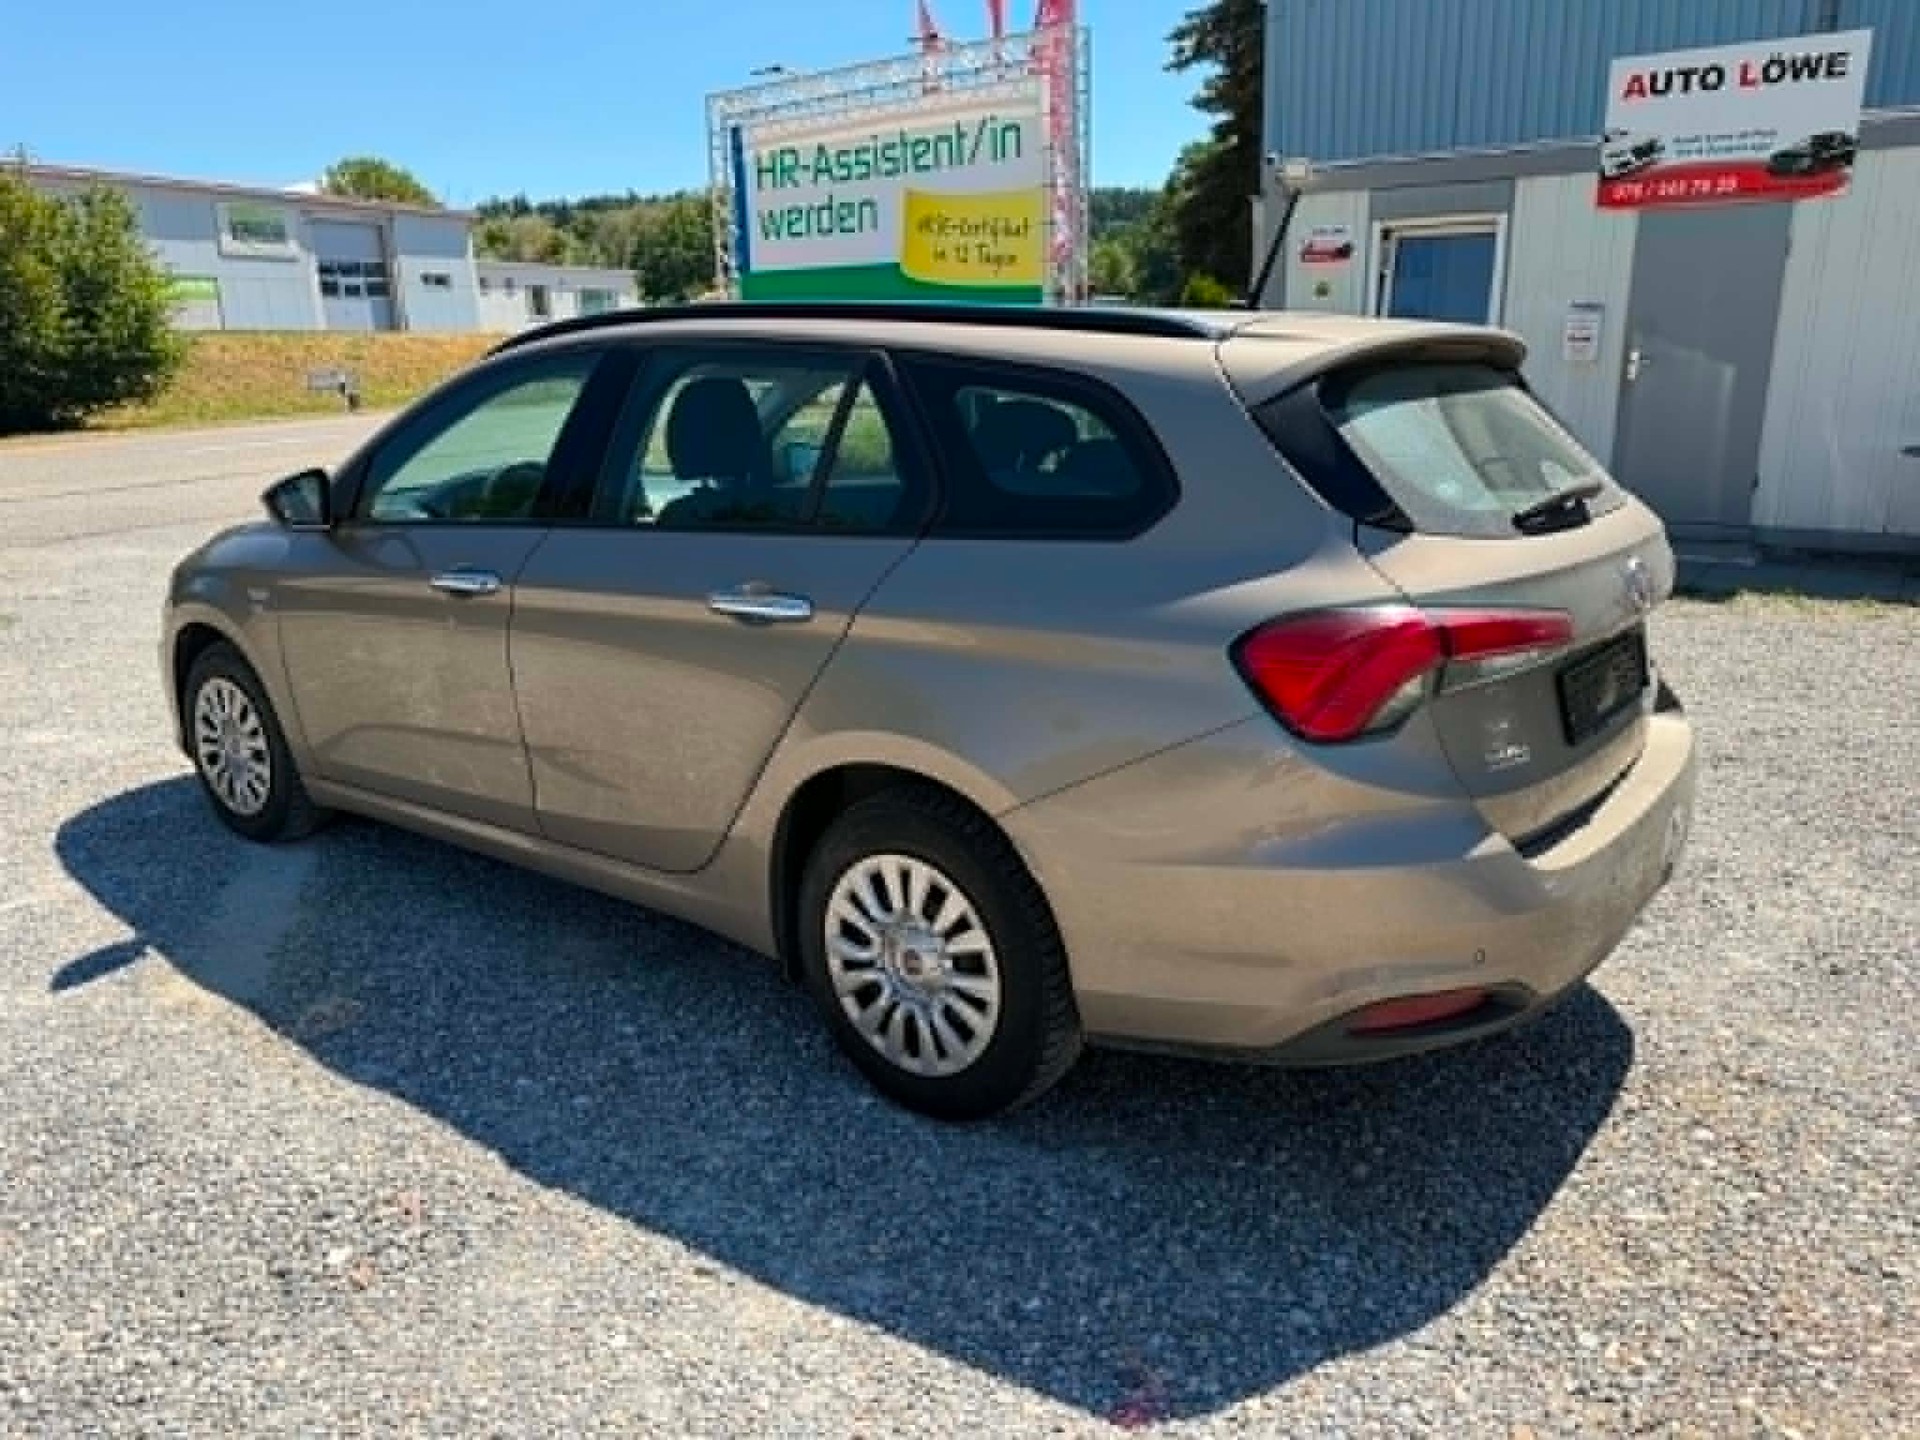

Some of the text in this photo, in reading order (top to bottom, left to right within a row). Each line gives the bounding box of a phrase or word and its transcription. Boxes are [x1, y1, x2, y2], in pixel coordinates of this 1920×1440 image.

[1622, 51, 1852, 99] AUTO LÖWE
[756, 114, 1022, 190] HR-Assistent/in
[759, 195, 878, 241] werden
